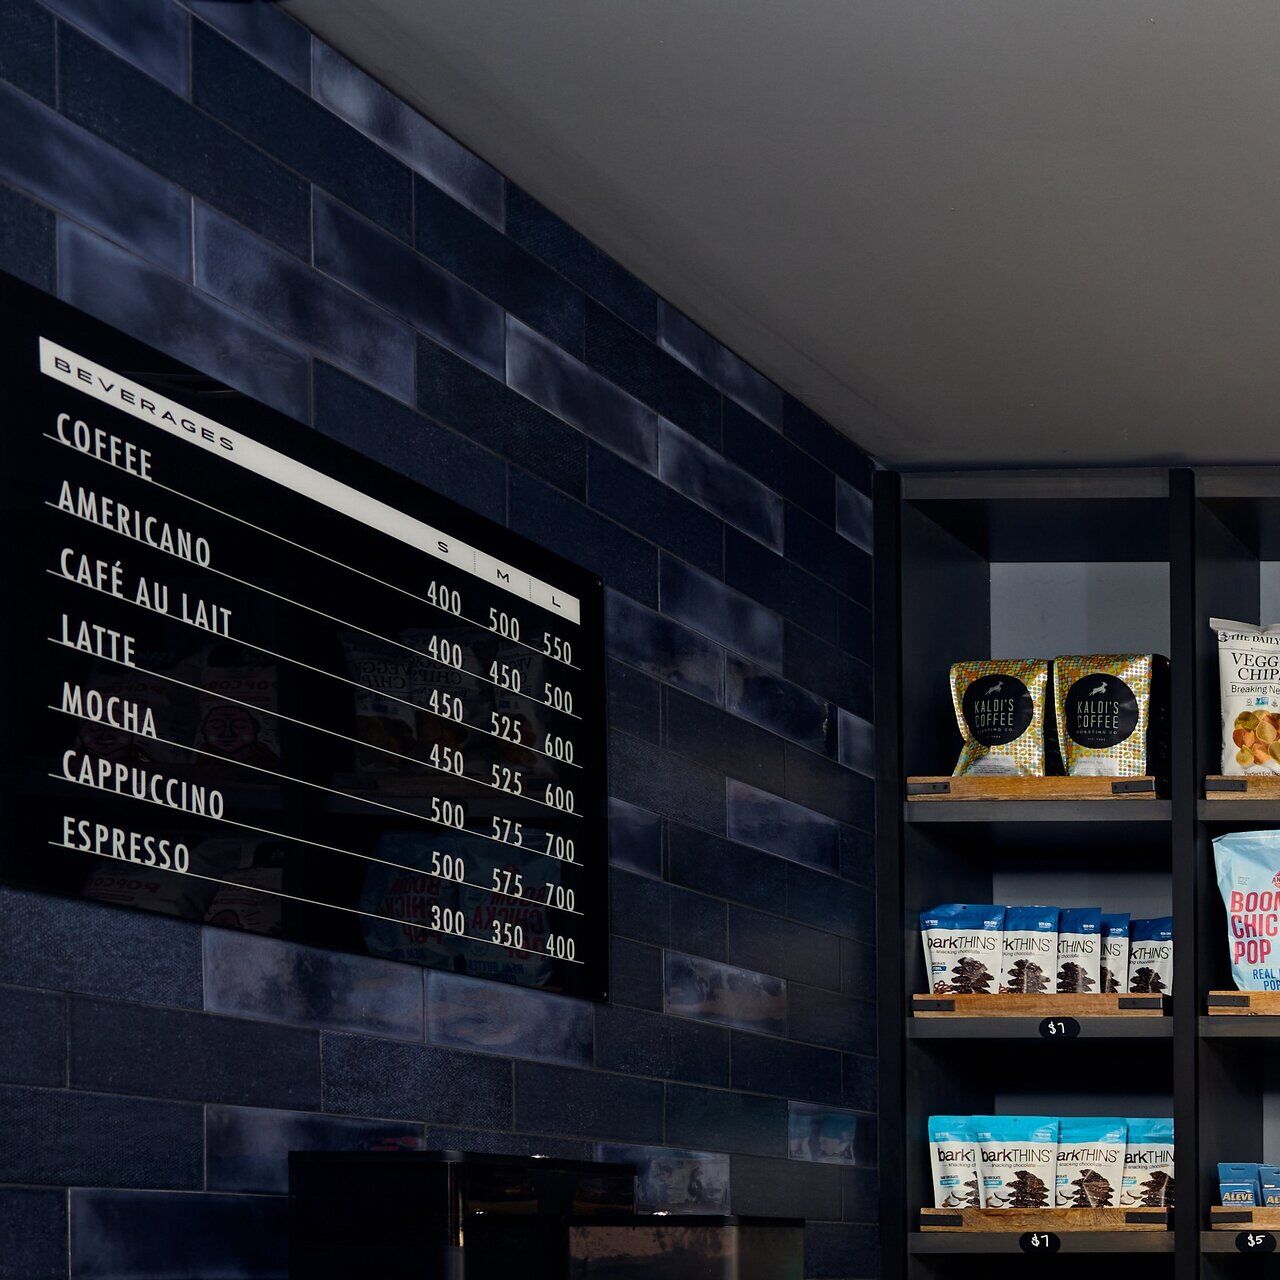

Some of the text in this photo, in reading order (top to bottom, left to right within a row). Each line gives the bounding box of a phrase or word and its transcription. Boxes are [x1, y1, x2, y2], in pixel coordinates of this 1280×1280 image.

[53, 356, 561, 607] BEVERAGES S M L
[57, 413, 572, 664] COFFEE 400 500 550
[58, 481, 573, 715] AMERICANO 400 450 500
[1253, 635, 1280, 644] DAILY
[61, 548, 574, 764] CAFÉ AU LAIT 450 525 600
[1232, 684, 1267, 695] Breaking
[62, 614, 575, 813] LATTE 450 525 600
[975, 699, 1014, 713] KALDI'S
[62, 682, 575, 863] MOCHA 500 575 700
[62, 750, 575, 911] CAPPUCCINO 500 575 700
[62, 816, 576, 960] ESPRESSO 300 350 400
[1234, 939, 1272, 965] POP
[1253, 968, 1275, 980] REAL
[1049, 1021, 1065, 1034] $7
[981, 1148, 1050, 1163] barkTHINS
[1223, 1193, 1253, 1202] ALEVE
[1031, 1233, 1048, 1247] $7
[1248, 1234, 1265, 1246] $5
